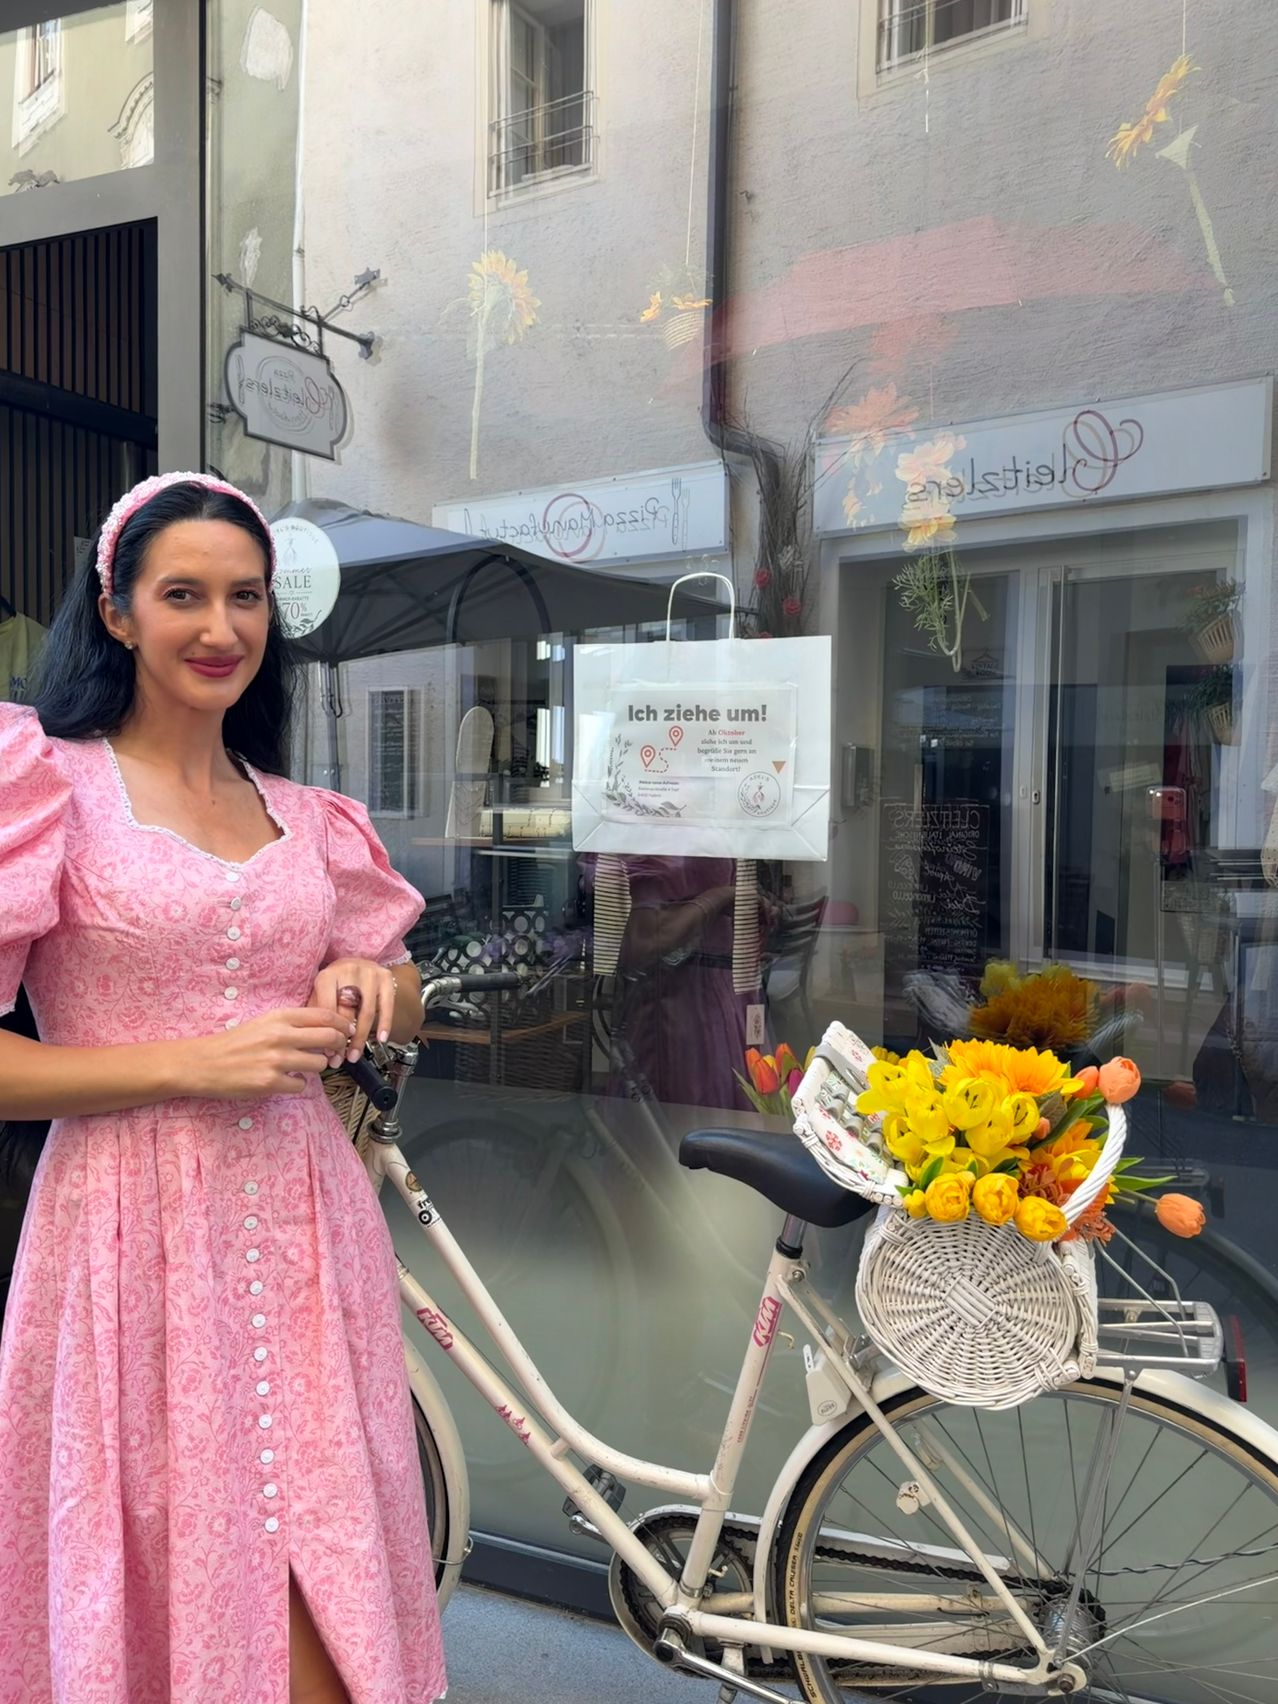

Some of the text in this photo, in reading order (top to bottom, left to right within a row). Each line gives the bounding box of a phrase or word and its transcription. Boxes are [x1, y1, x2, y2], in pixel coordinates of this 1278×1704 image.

[274, 575, 312, 590] SALE
[628, 703, 767, 722] Ich ziehe um!
[418, 1309, 452, 1350] KTM
[754, 1297, 780, 1346] KTM
